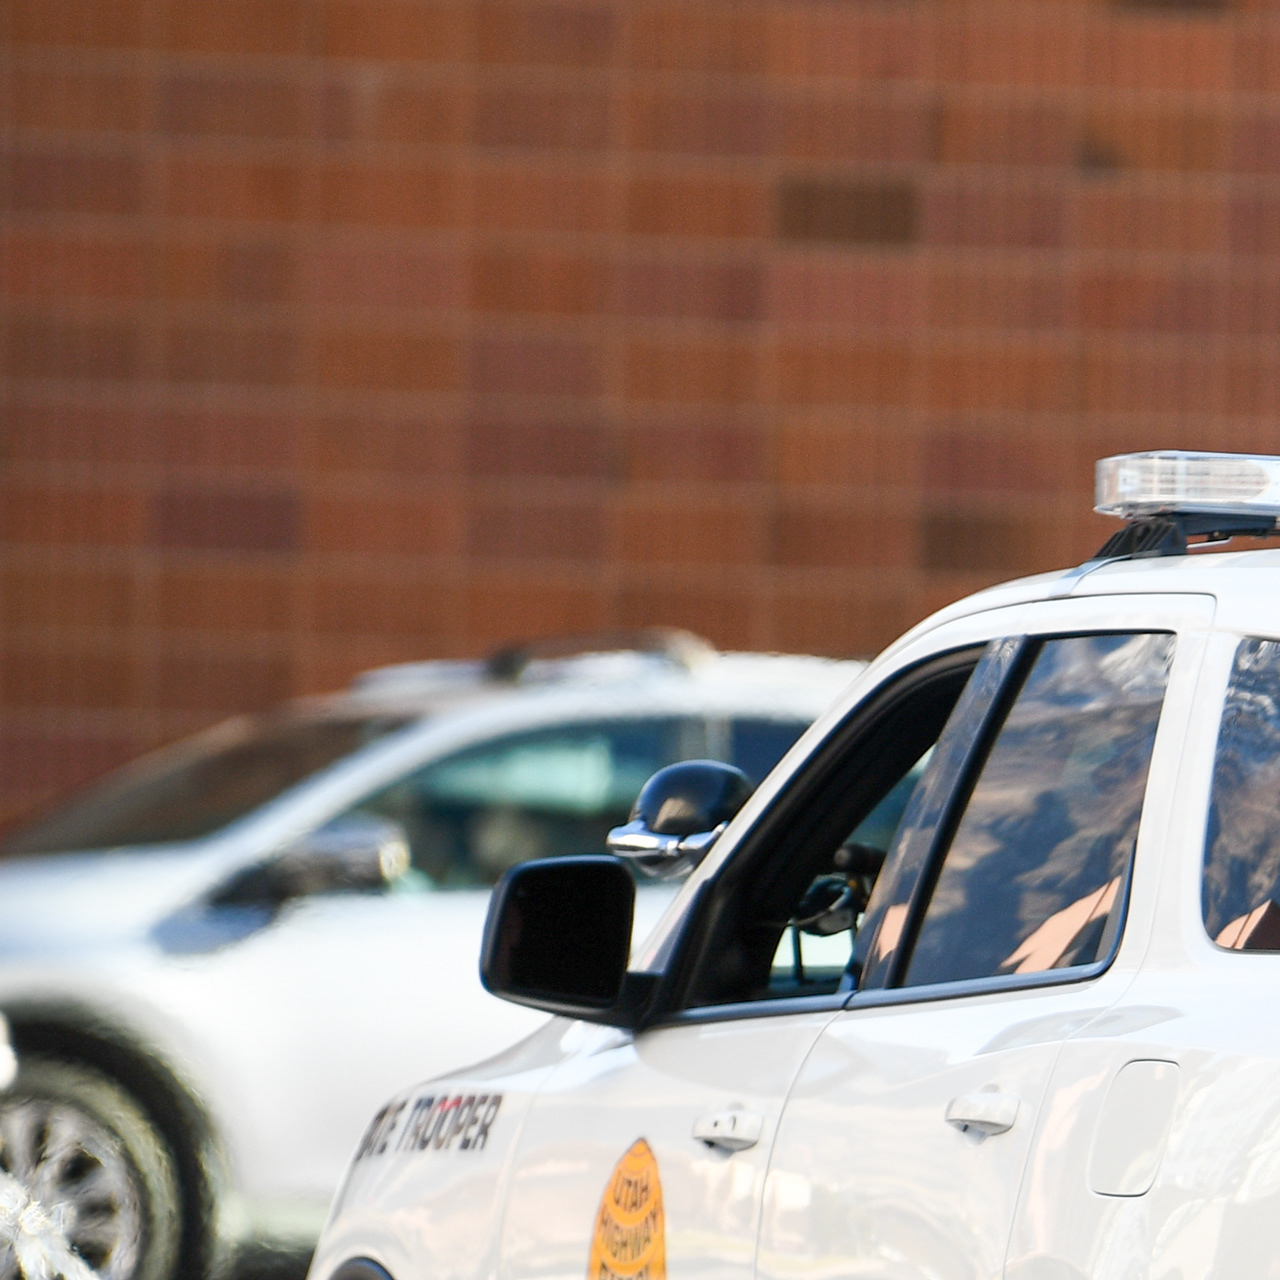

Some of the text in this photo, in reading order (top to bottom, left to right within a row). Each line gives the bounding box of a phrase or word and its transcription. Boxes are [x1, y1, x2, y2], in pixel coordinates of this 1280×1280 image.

[395, 1094, 503, 1151] TROOPER
[612, 1170, 650, 1213] UTAH
[598, 1201, 658, 1263] HIGHWAY
